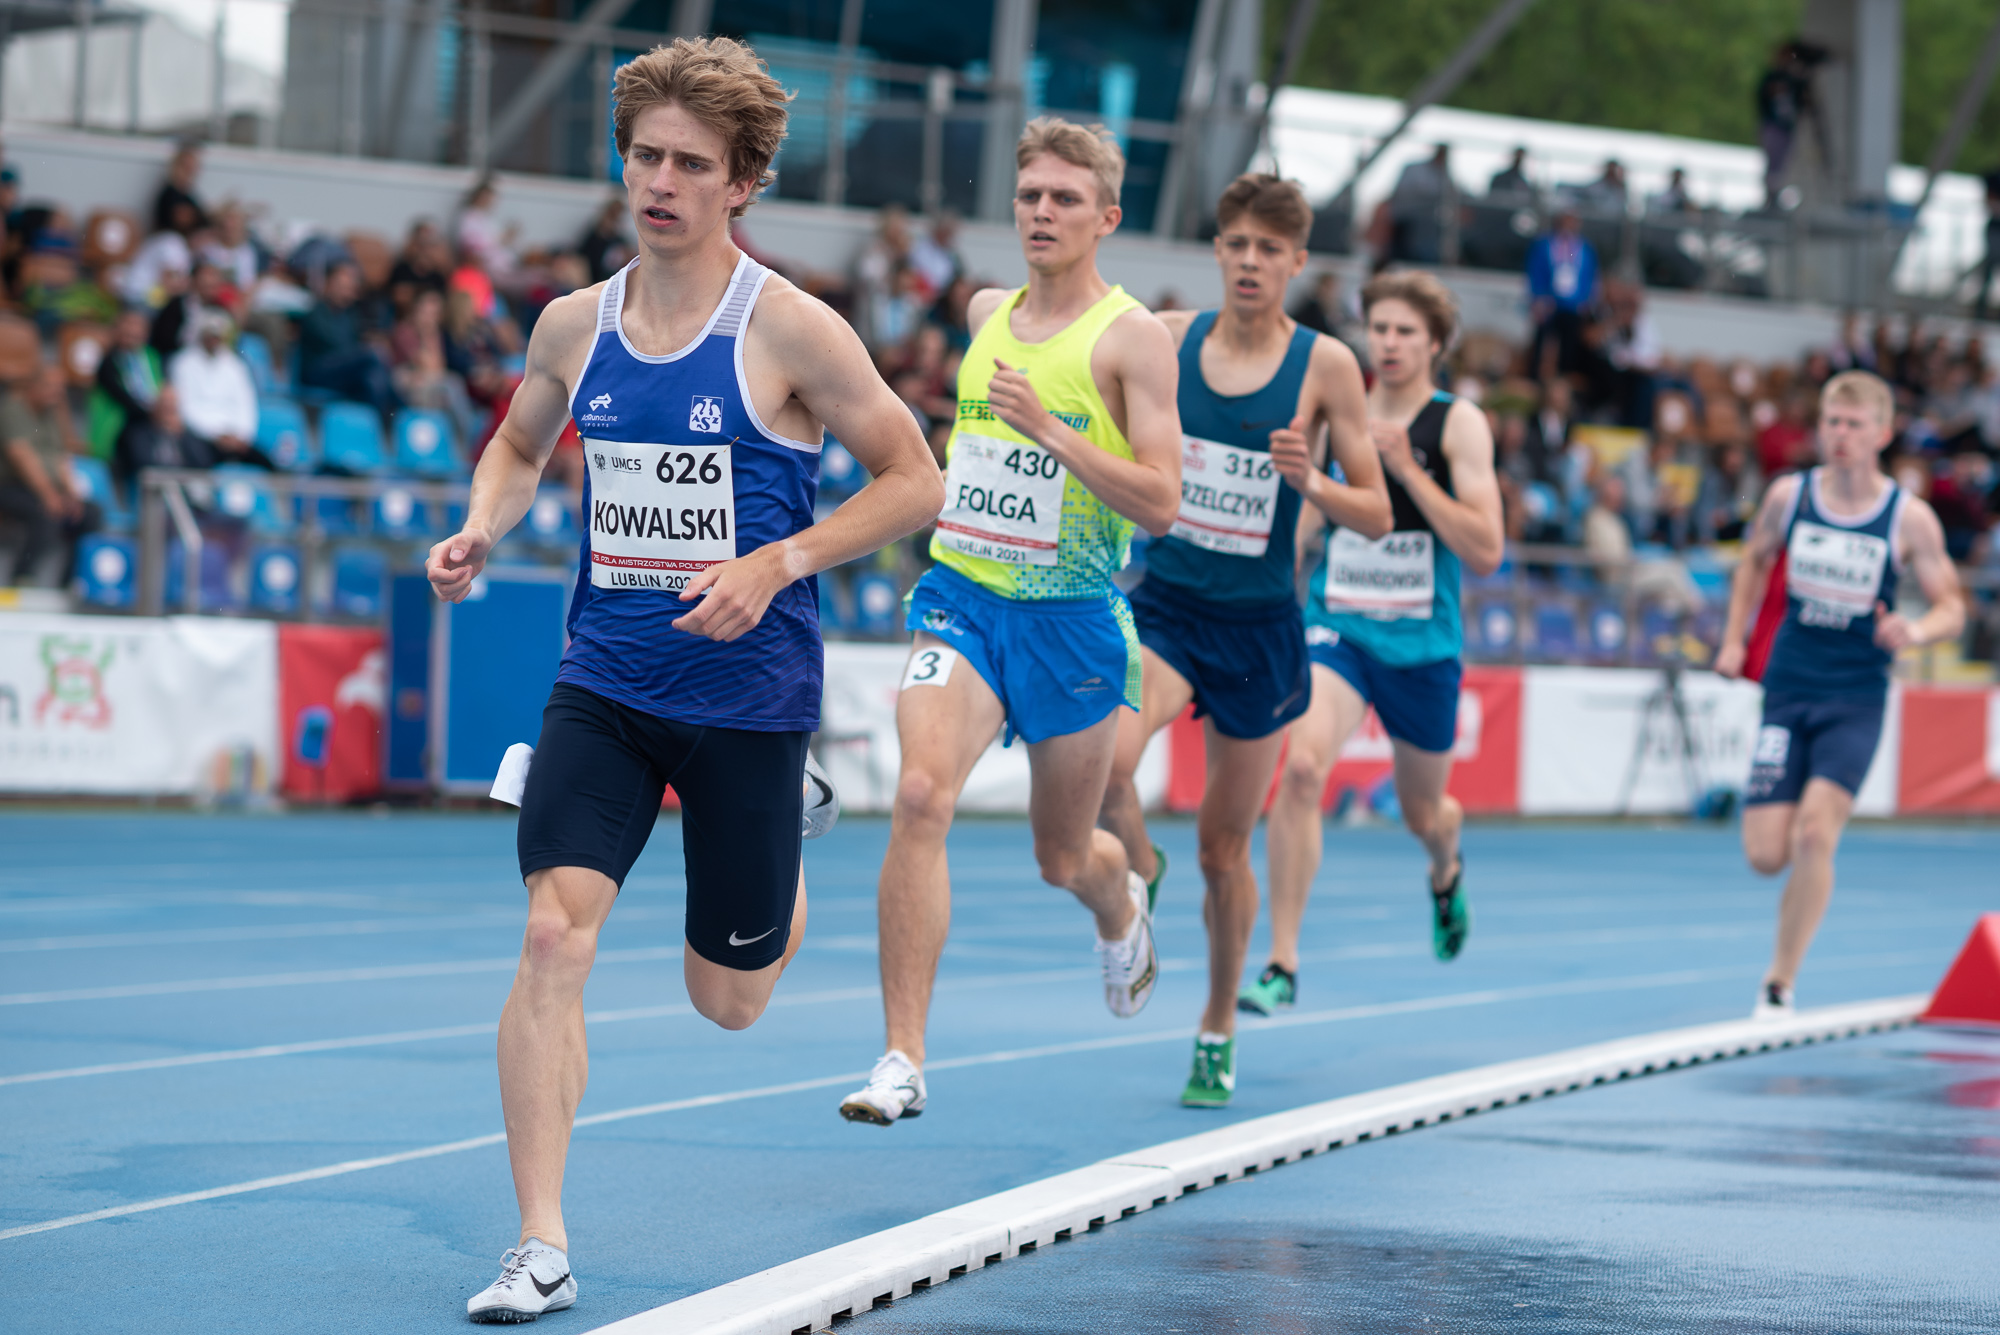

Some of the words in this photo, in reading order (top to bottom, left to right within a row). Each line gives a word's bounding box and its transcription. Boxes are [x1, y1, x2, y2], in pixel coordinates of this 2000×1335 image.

[611, 457, 641, 470] UMCS
[656, 451, 722, 484] 626
[1004, 449, 1059, 480] 430
[1224, 453, 1273, 480] 316
[956, 484, 1037, 523] FOLGA
[1181, 481, 1269, 519] RZELCZYK
[594, 500, 728, 540] KOWALSKI
[601, 555, 617, 565] PZLA
[618, 558, 677, 568] MISTRZOSTWA
[957, 538, 992, 556] LUBLIN
[996, 547, 1026, 561] 2021
[611, 572, 661, 588] LUBLIN
[665, 575, 691, 590] 202
[913, 651, 942, 682] 3
